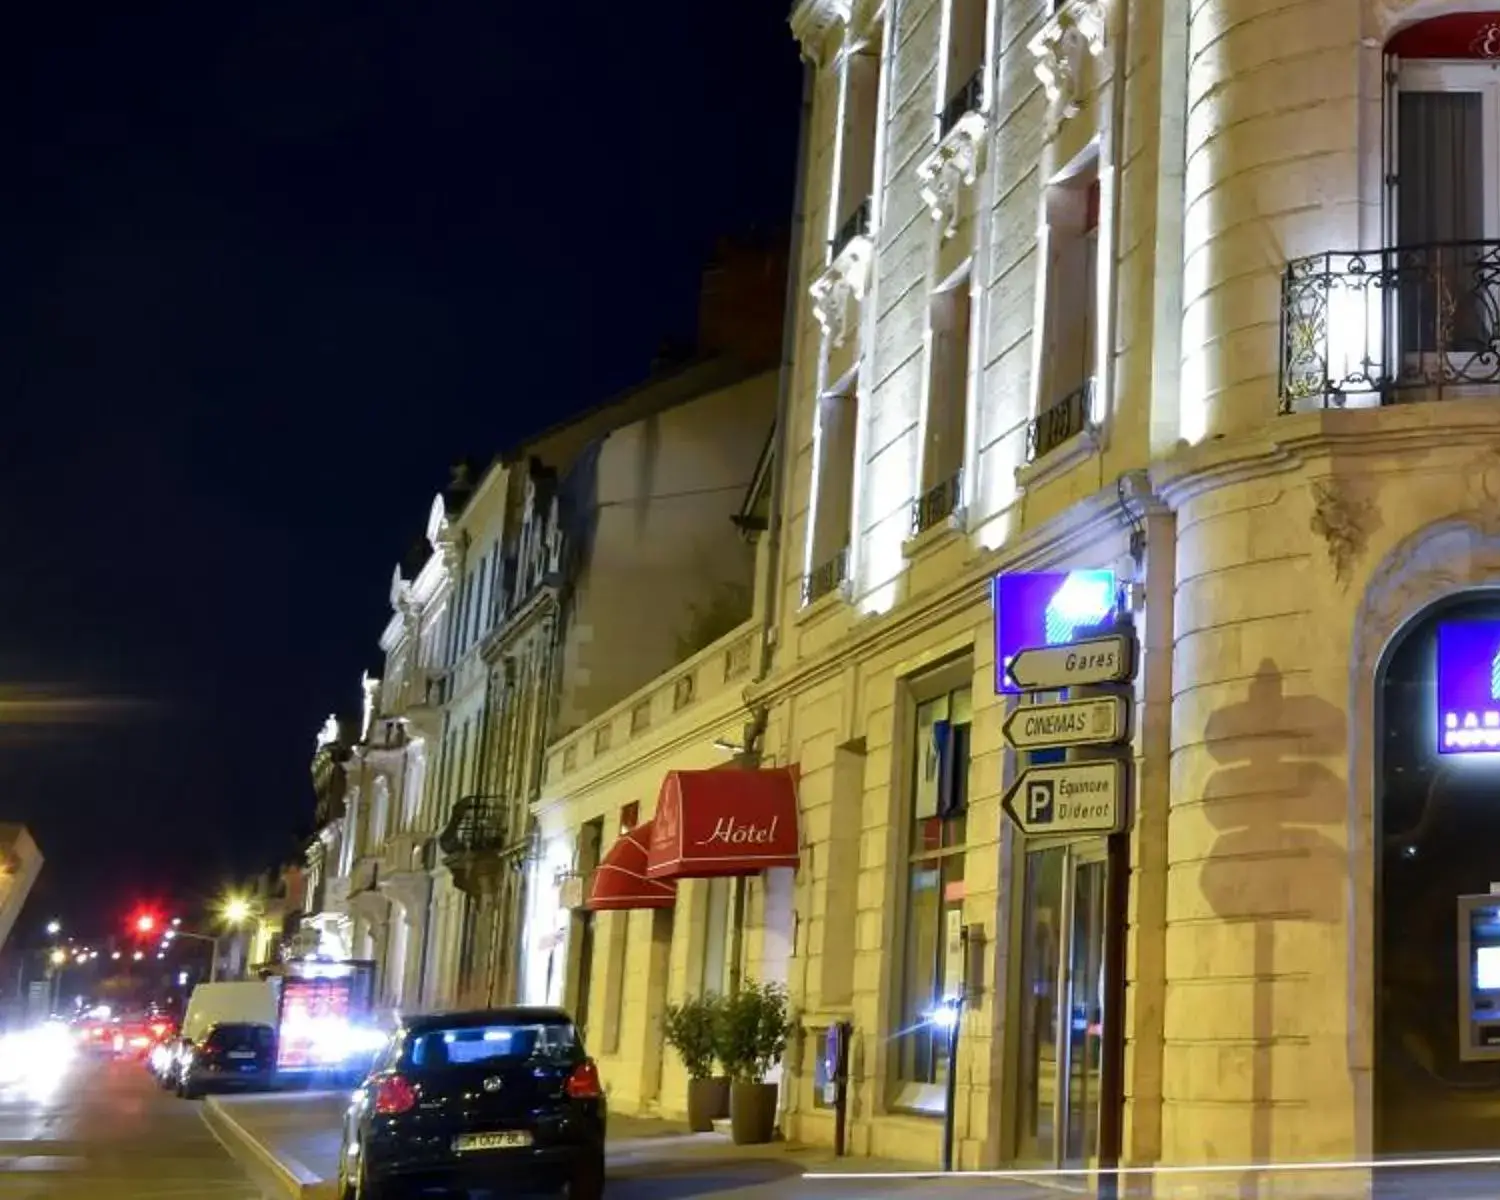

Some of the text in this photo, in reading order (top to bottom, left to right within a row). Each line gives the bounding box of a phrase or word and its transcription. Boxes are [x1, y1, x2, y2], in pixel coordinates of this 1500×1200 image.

[1065, 652, 1114, 671] Gares
[1025, 711, 1085, 736] CINEMAS
[1059, 803, 1109, 820] Diderot
